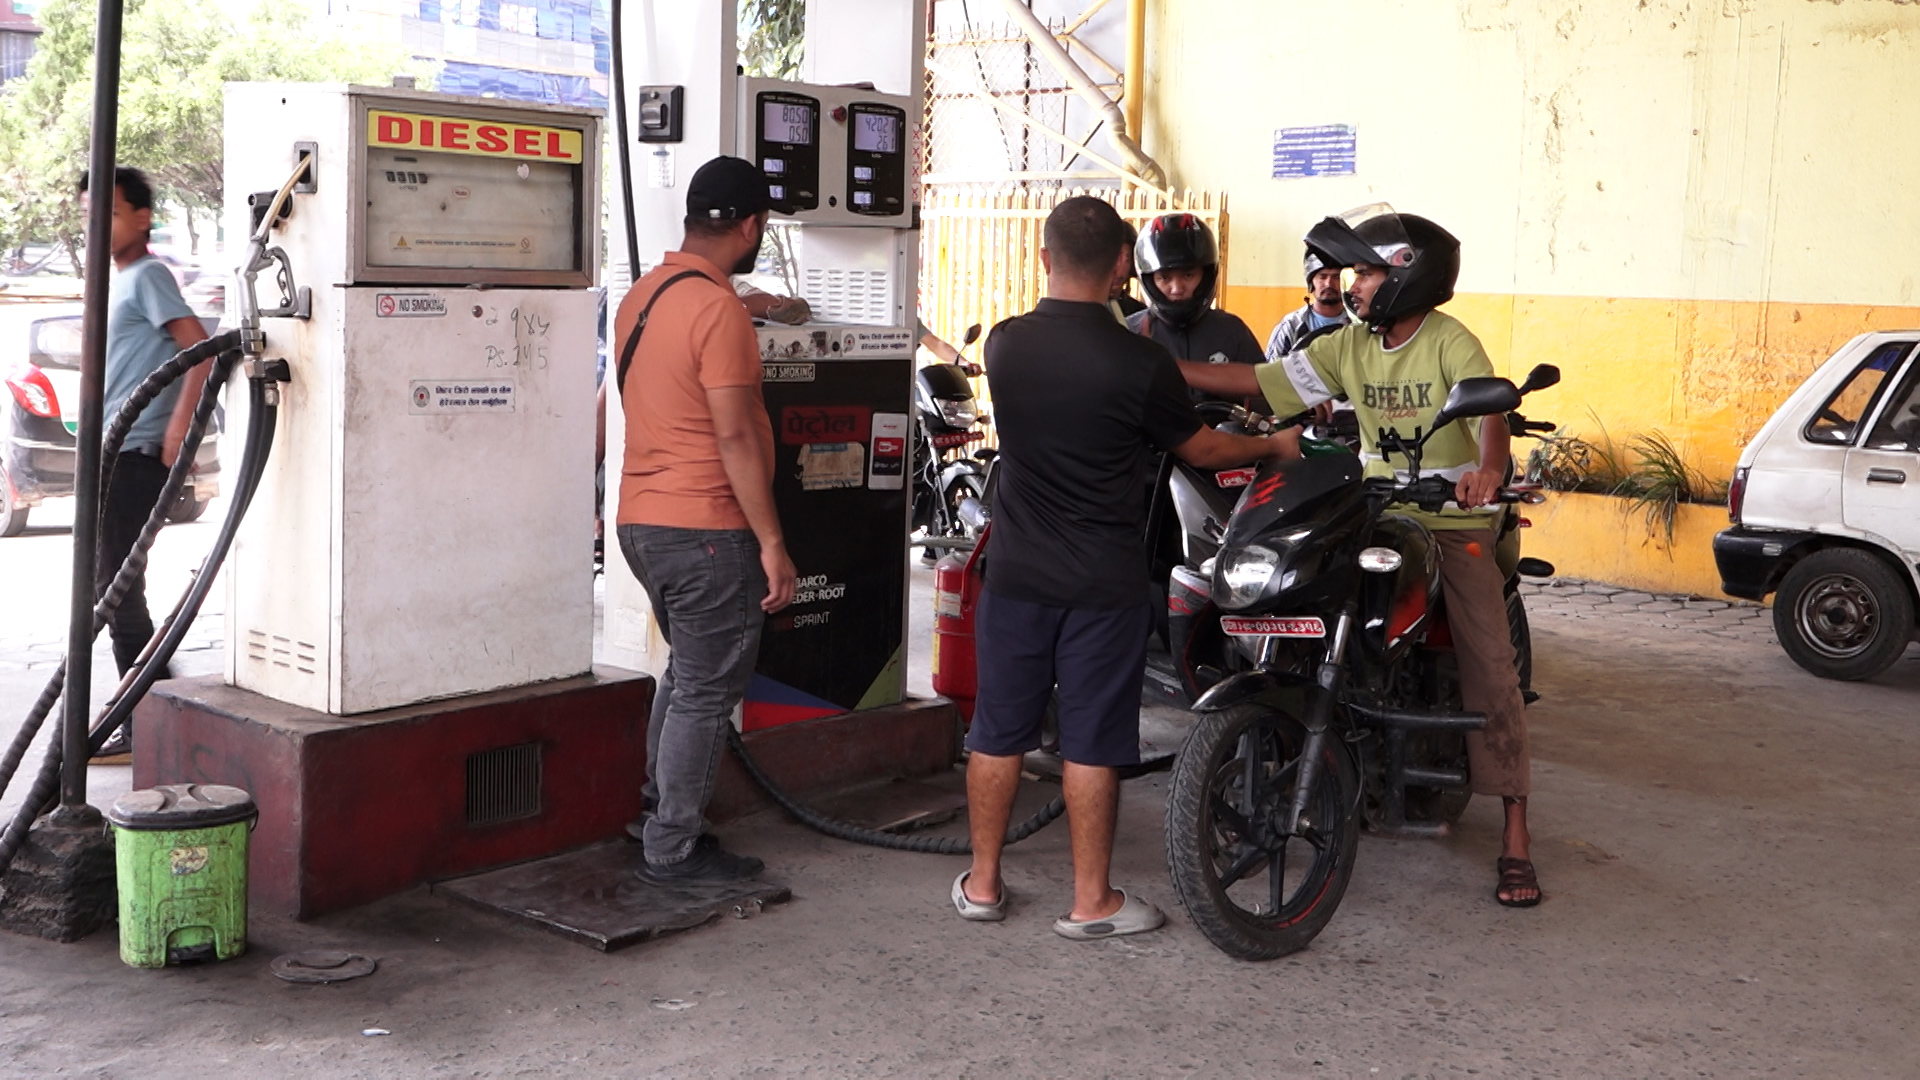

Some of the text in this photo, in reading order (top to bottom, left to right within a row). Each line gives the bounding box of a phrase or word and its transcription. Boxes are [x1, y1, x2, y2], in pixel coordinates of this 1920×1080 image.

[377, 115, 572, 158] DIESEL
[399, 299, 410, 312] NO
[766, 366, 812, 378] NO SMOKING
[787, 409, 857, 439] पेट्रोल
[793, 611, 830, 629] SPRINT
